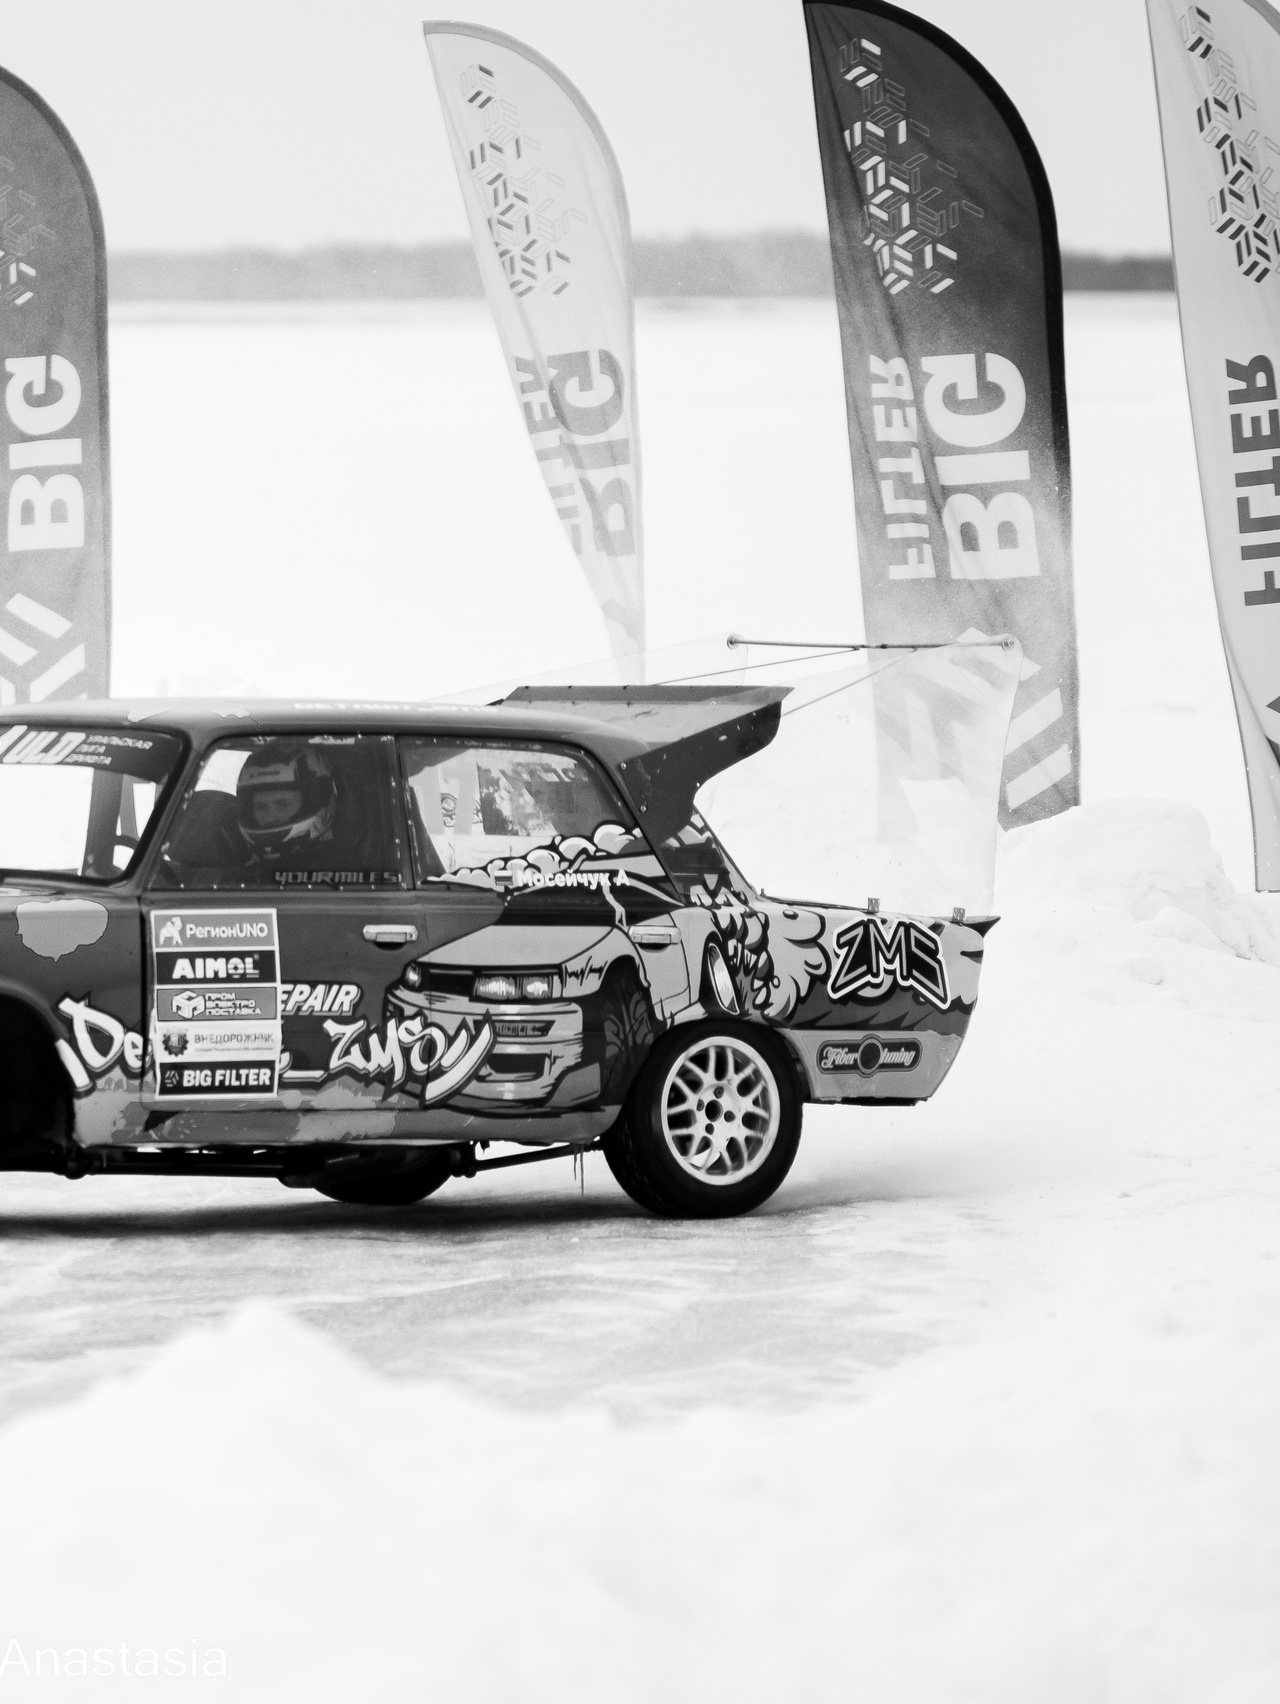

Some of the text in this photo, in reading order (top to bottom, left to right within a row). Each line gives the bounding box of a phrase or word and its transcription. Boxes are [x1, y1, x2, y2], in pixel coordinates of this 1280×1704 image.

[517, 869, 612, 890] Мосейчук
[186, 922, 269, 938] РегионUNO
[172, 957, 260, 979] AIMOL
[183, 1068, 272, 1088] BIG FILTER
